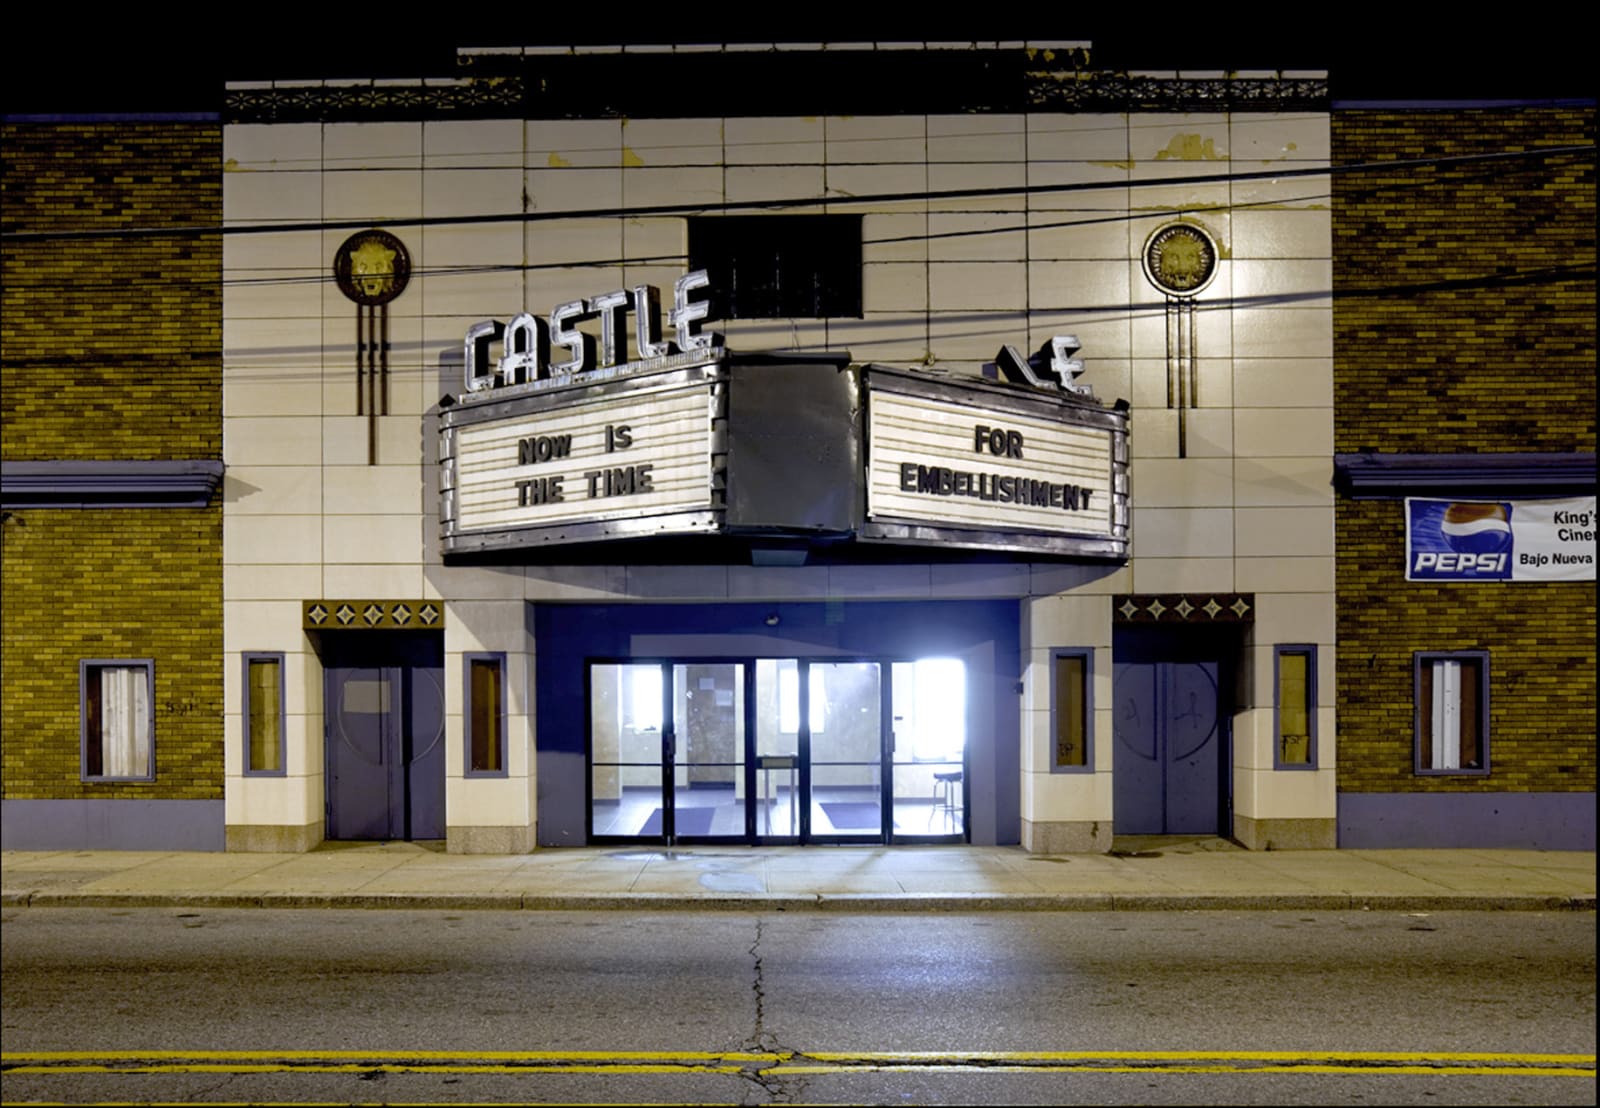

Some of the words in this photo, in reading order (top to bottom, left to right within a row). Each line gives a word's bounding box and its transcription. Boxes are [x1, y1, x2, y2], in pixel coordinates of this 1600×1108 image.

[465, 269, 716, 392] CASTLE
[518, 434, 572, 466] NOW
[604, 424, 633, 452] IS
[974, 424, 1024, 459] FOR
[515, 475, 565, 507] THE
[584, 464, 654, 498] TIME
[900, 462, 1093, 510] EMBELLISHMENT
[1413, 552, 1508, 573] PEPSI
[1519, 552, 1549, 567] Bajo
[1552, 552, 1593, 565] Nueva
